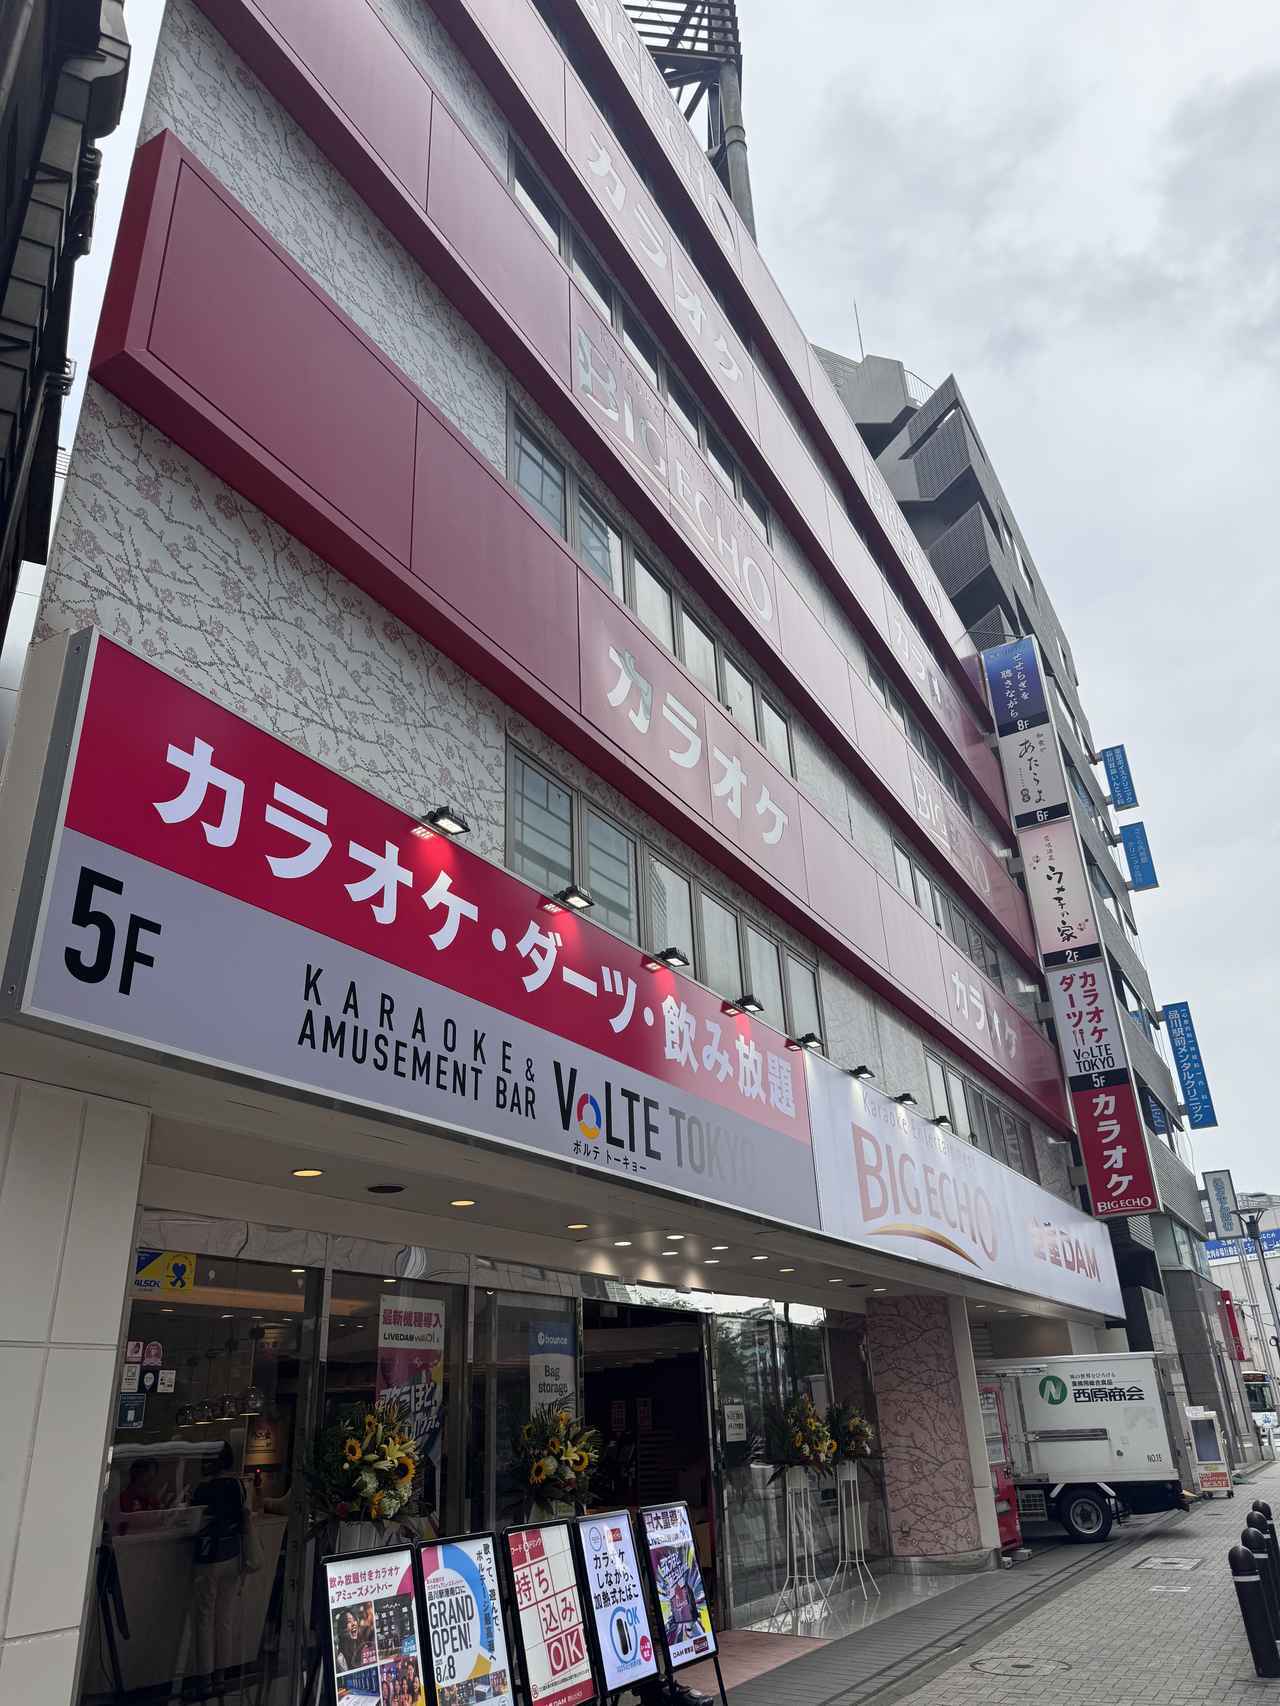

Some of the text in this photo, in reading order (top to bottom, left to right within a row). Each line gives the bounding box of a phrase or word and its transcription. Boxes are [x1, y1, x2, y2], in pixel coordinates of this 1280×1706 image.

[1016, 719, 1030, 731] 8F
[606, 646, 790, 846] カラオケ
[1036, 810, 1049, 823] 6F
[64, 866, 162, 996] 5F
[1065, 950, 1080, 963] 2F
[1059, 973, 1084, 1029] ダーツ
[1079, 971, 1108, 1044] カラオケ
[303, 963, 536, 1083] KARAOKE &
[297, 1008, 537, 1120] AMUSEMENT BAR
[1075, 1056, 1116, 1073] TOKYO
[1168, 1010, 1204, 1122] 品川駅前メンタルクリニック
[1091, 1073, 1106, 1089] 5F
[573, 1139, 601, 1161] ボルテ
[1092, 1094, 1133, 1197] カラオケ
[851, 1121, 999, 1264] BIG ECHO
[543, 1364, 561, 1380] Bag
[538, 1381, 569, 1396] storage
[1072, 1385, 1145, 1403] 西原商会
[329, 1566, 400, 1588] 飲み放題付きカラオケ
[593, 1585, 639, 1609] 加熱式たばこ
[428, 1595, 475, 1630] GRAND
[626, 1607, 640, 1626] OK
[431, 1622, 473, 1658] OPEN!
[550, 1629, 585, 1672] OK
